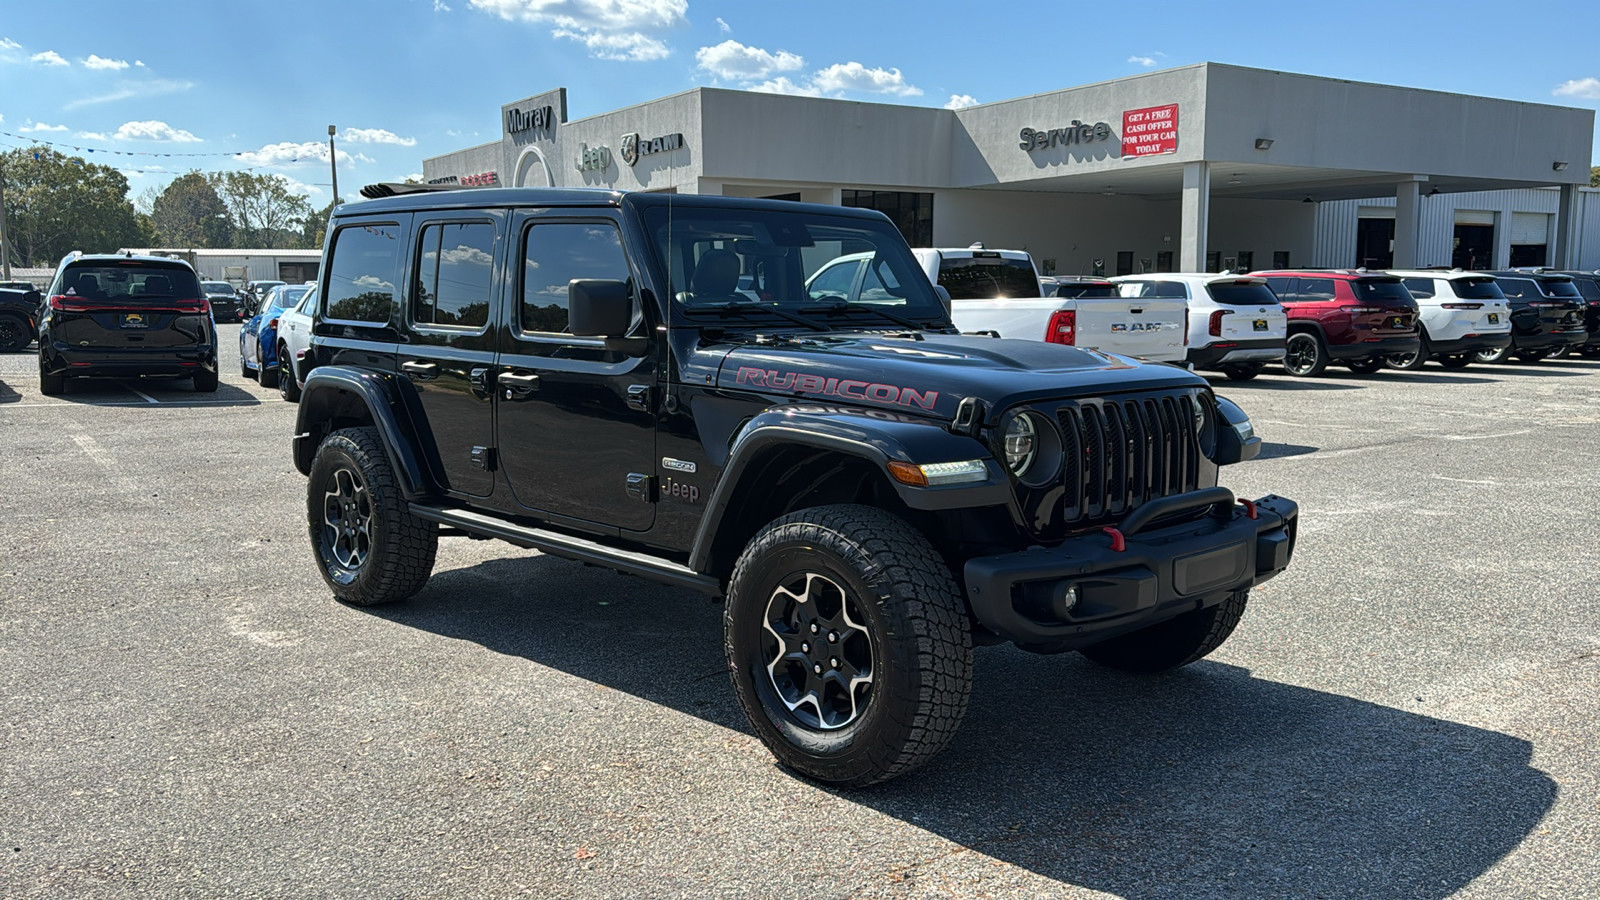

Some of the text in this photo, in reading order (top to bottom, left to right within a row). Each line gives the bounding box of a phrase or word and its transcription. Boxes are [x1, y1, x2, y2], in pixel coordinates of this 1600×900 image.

[506, 106, 551, 133] Murray
[1128, 109, 1171, 122] GET A FREE
[1019, 120, 1109, 151] Service
[1126, 120, 1172, 133] CASH OFFER
[638, 133, 682, 156] RAM
[1122, 131, 1176, 145] FOR YOUR CAR
[574, 142, 611, 174] Jeep
[1135, 144, 1161, 154] TODAY
[461, 171, 497, 186] DODGE
[1111, 322, 1161, 333] RAM
[736, 366, 939, 409] RUBICON
[661, 477, 699, 503] Jeep
